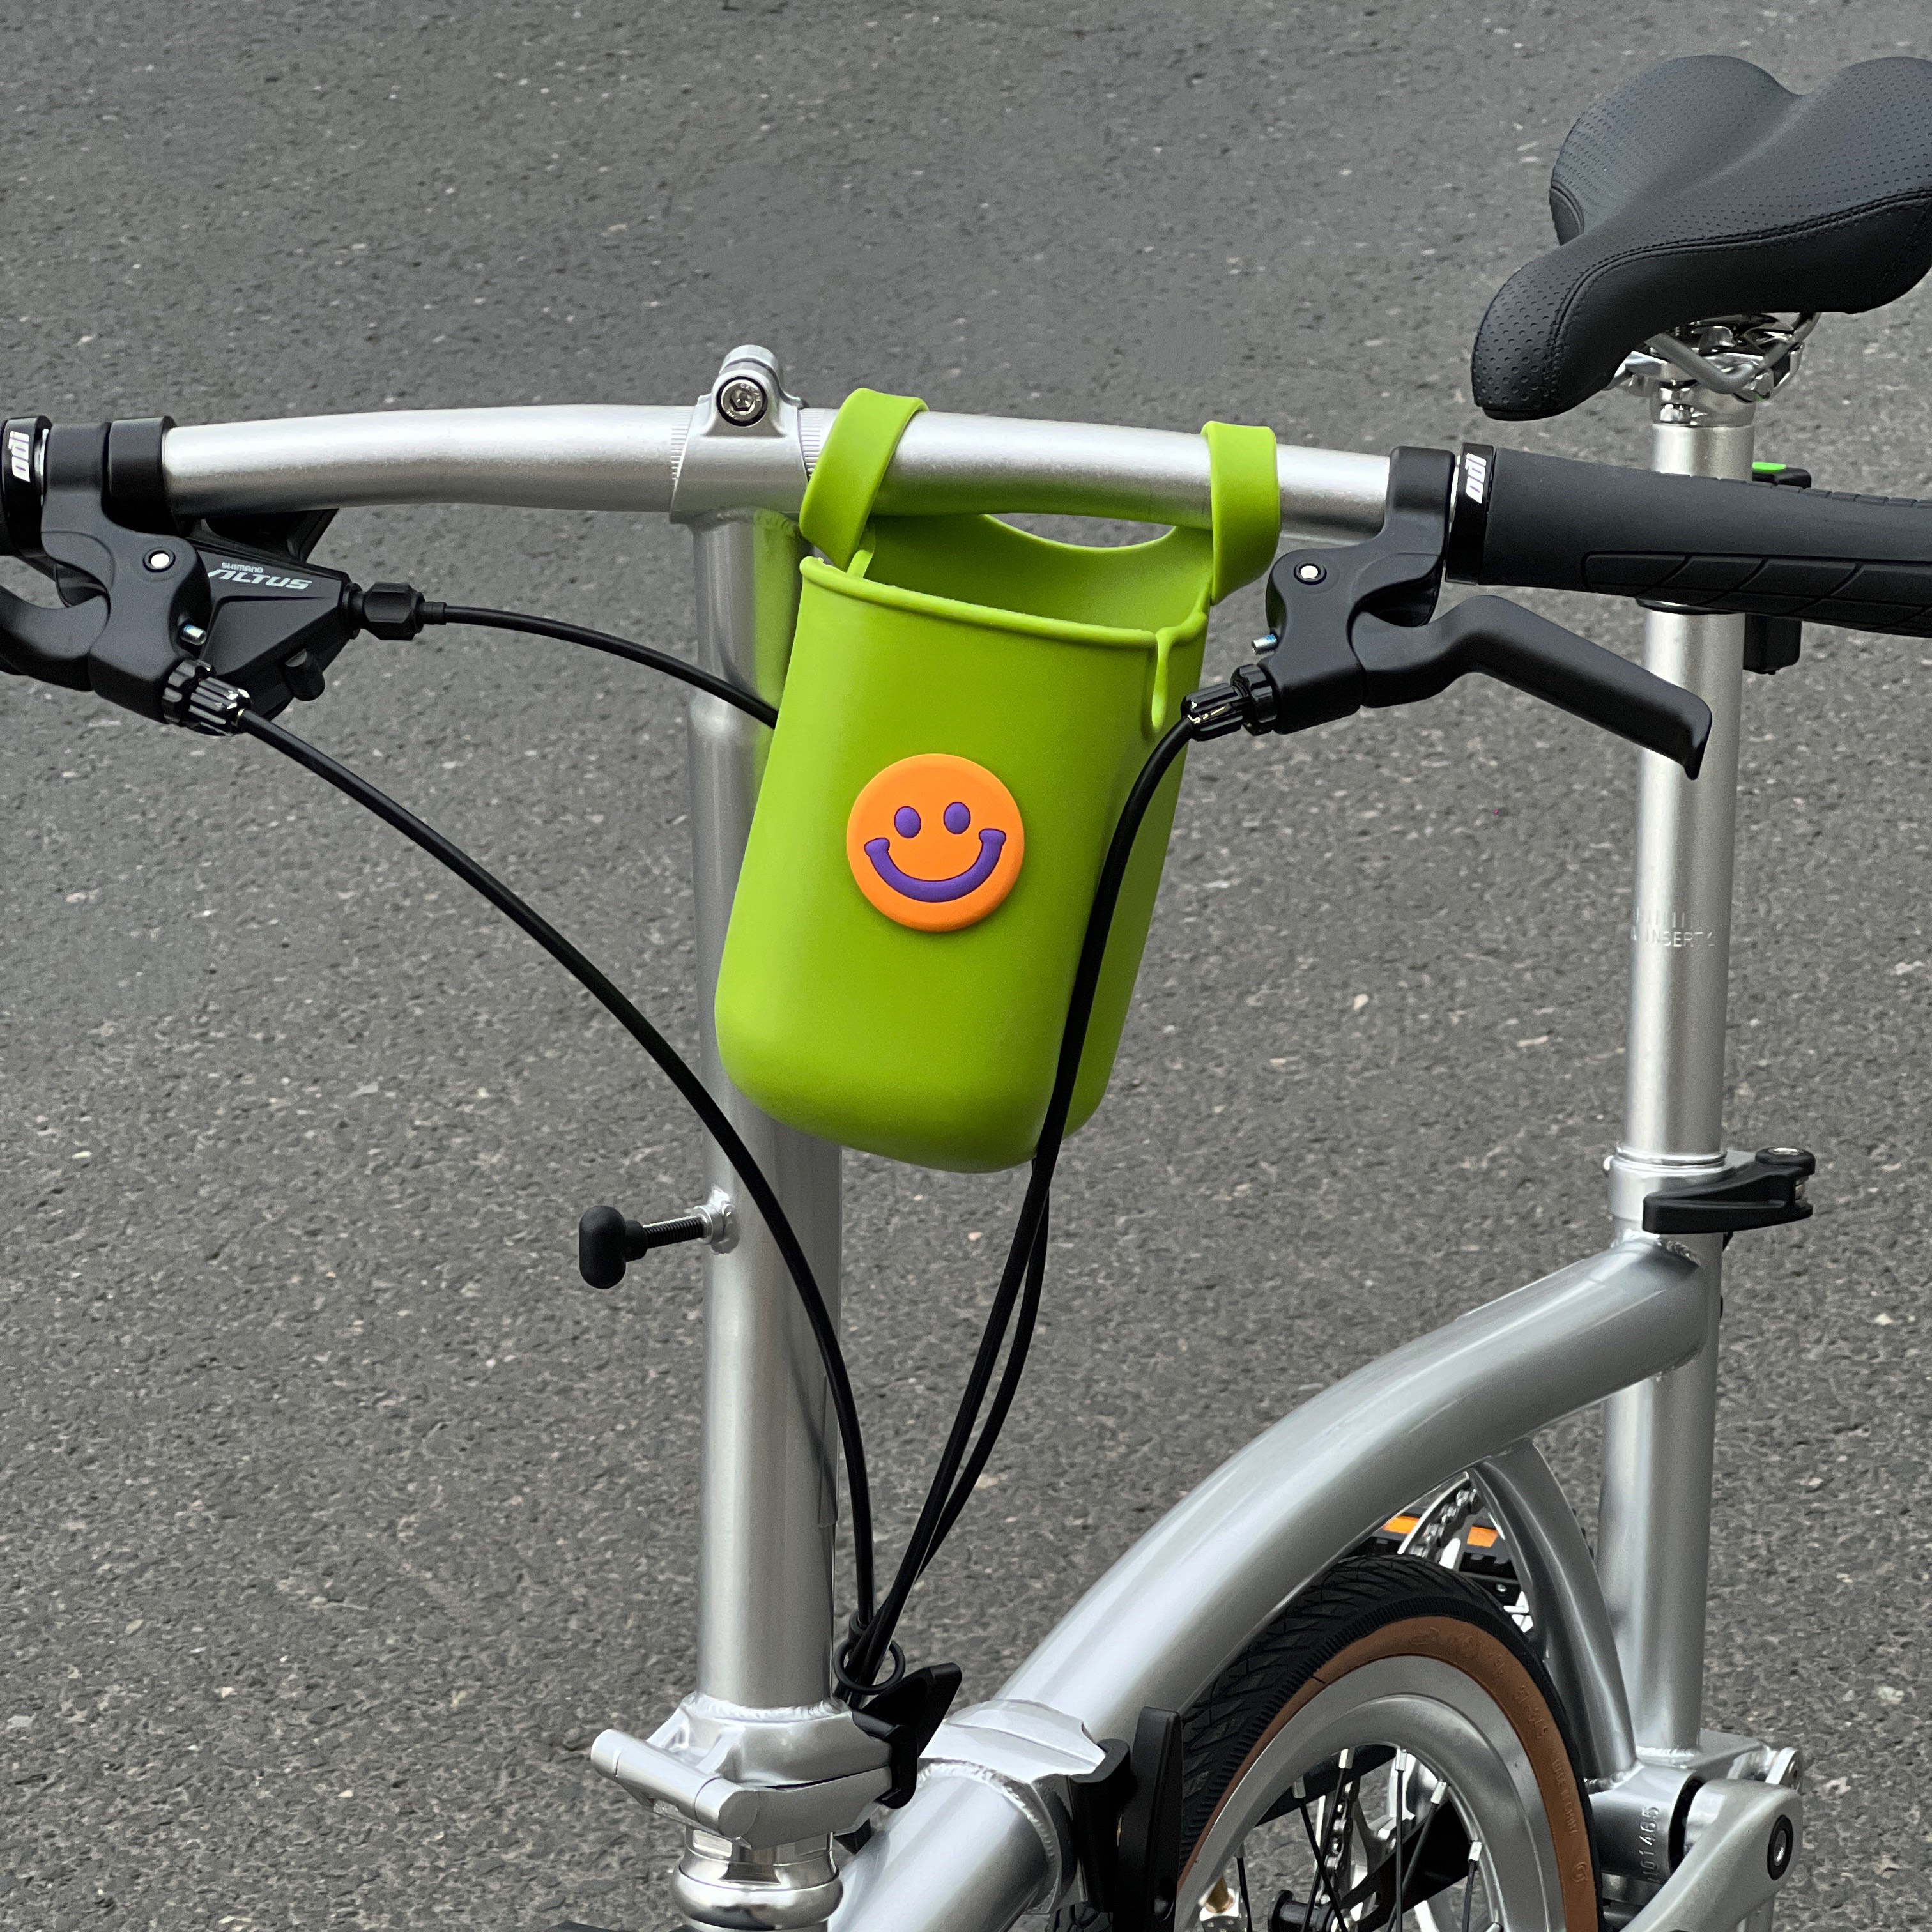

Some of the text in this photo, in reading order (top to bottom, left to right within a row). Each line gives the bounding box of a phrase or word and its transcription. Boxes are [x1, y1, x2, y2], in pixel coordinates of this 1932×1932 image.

[8, 431, 30, 482] odi
[1465, 452, 1487, 504] odi
[208, 569, 312, 590] ALTUS
[221, 562, 264, 573] SHIMANO
